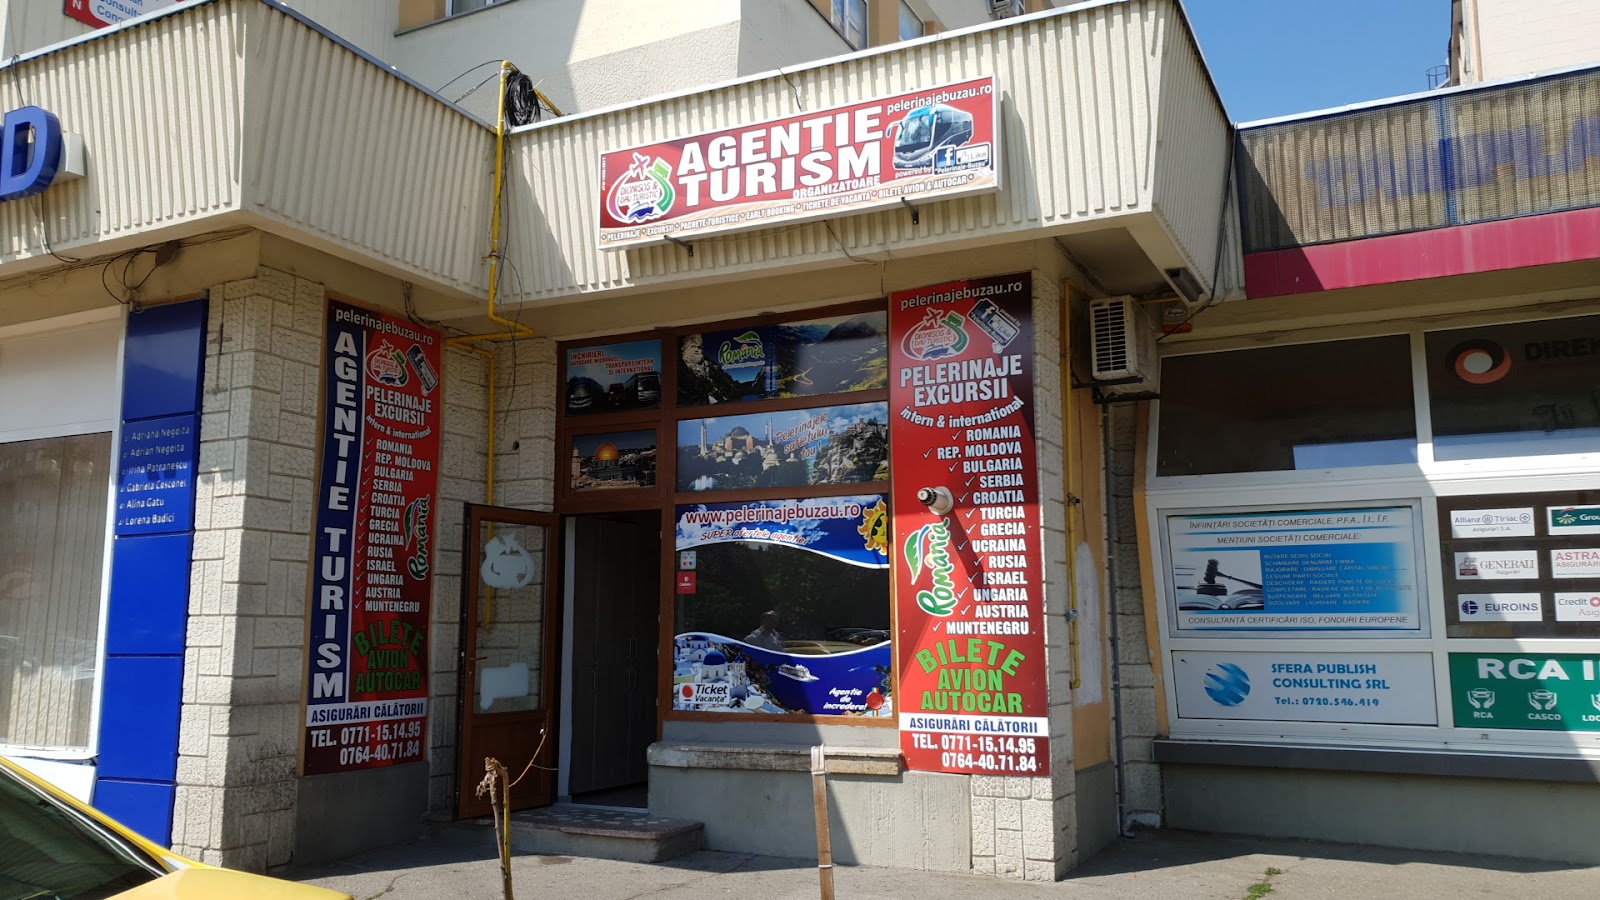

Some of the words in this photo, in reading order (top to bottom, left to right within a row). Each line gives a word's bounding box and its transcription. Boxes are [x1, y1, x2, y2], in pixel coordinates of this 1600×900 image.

[887, 84, 992, 116] pelerinajebuzau.ro
[676, 105, 884, 177] AGENTIE
[678, 141, 881, 208] TURISM
[895, 167, 922, 180] powered
[923, 166, 933, 175] by
[792, 175, 881, 200] ORGANIZATOARE
[607, 229, 641, 242] PELERINAJE
[646, 224, 674, 236] EXCURSII
[680, 219, 706, 230] PACHETE
[707, 214, 740, 228] TURISTICE
[746, 209, 766, 220] EARLY
[766, 204, 795, 218] BOOKING
[802, 200, 828, 212] TICHETE
[830, 198, 840, 207] DE
[878, 188, 903, 198] BILETE
[904, 184, 924, 195] AVION
[926, 182, 932, 190] &
[934, 175, 968, 190] AUTOCAR
[900, 281, 1022, 311] pelerinajebuzau.ro
[335, 308, 434, 346] pelerinajebuzau.ro
[900, 354, 1022, 388] PELERINAJE
[366, 386, 432, 413] PELERINAJE
[914, 378, 1008, 407] EXCURSII
[374, 402, 424, 426] EXCURSII
[900, 406, 934, 426] intern
[936, 416, 946, 428] &
[949, 396, 1024, 428] international
[328, 331, 358, 511] AGENTIE
[366, 414, 384, 432] intern
[386, 426, 392, 435] &
[393, 426, 432, 440] international
[775, 412, 828, 444] Pelerinajele
[784, 426, 829, 454] sufletului
[966, 425, 1022, 442] ROMANIA
[376, 439, 412, 455] ROMANIA
[937, 447, 962, 460] REP.
[965, 441, 1022, 458] MOLDOVA
[375, 452, 392, 466] REP.
[394, 455, 431, 471] MOLDOVA
[963, 457, 1023, 474] BULGARIA
[374, 466, 414, 481] BULGARIA
[980, 474, 1024, 488] SERBIA
[373, 479, 402, 492] SERBIA
[372, 492, 406, 506] CROATIA
[972, 490, 1024, 504] CROATIA
[370, 506, 400, 518] TURCIA
[685, 503, 862, 526] www.pelerinajebuzau.ro
[980, 506, 1026, 520] TURCIA
[1454, 516, 1480, 524] Allianz
[126, 516, 150, 526] Lorena
[369, 519, 399, 532] GRECIA
[980, 522, 1026, 536] GRECIA
[368, 532, 404, 546] UCRAINA
[700, 528, 732, 540] SUPER
[734, 527, 770, 538] ofertele
[770, 532, 810, 545] agentiei
[368, 546, 393, 558] RUSIA
[972, 538, 1026, 552] UCRAINA
[988, 555, 1027, 568] RUSIA
[1555, 552, 1600, 560] ASTRA
[366, 560, 396, 572] ISRAEL
[1480, 560, 1534, 569] GENERALI
[368, 574, 404, 586] UNGARIA
[983, 572, 1028, 585] ISRAEL
[366, 587, 401, 599] AUSTRIA
[974, 588, 1028, 602] UNGARIA
[312, 527, 347, 699] TURISM
[365, 600, 420, 612] MUNTENEGRU
[975, 604, 1029, 618] AUSTRIA
[1485, 603, 1538, 611] EUROINS
[946, 621, 1029, 635] MUNTENEGRU
[1318, 616, 1358, 624] FONDURI
[1359, 616, 1408, 624] EUROPENE
[354, 620, 424, 656] BILETE
[368, 649, 410, 670] AVION
[915, 638, 1026, 676] BILETE
[1271, 663, 1312, 674] SFERA
[1317, 664, 1376, 674] PUBLISH
[1477, 658, 1570, 680] RCA
[356, 671, 421, 693] AUTOCAR
[938, 668, 1003, 692] AVION
[1272, 678, 1362, 689] CONSULTING
[1366, 679, 1390, 690] SRL
[695, 684, 728, 694] Ticket
[829, 687, 863, 696] Agentie
[823, 702, 868, 711] incredere!
[920, 690, 1024, 714] AUTOCAR
[1275, 696, 1299, 705] Tel.:
[1302, 697, 1379, 707] 0720.546.419
[311, 729, 337, 748] TEL.
[340, 721, 421, 746] 0771-15.14.95
[912, 734, 938, 749] TEL.
[942, 734, 1036, 754] 0771-15.14.95
[340, 740, 420, 765] 0764-40.71.84
[942, 752, 1036, 772] 0764-40.71.84
